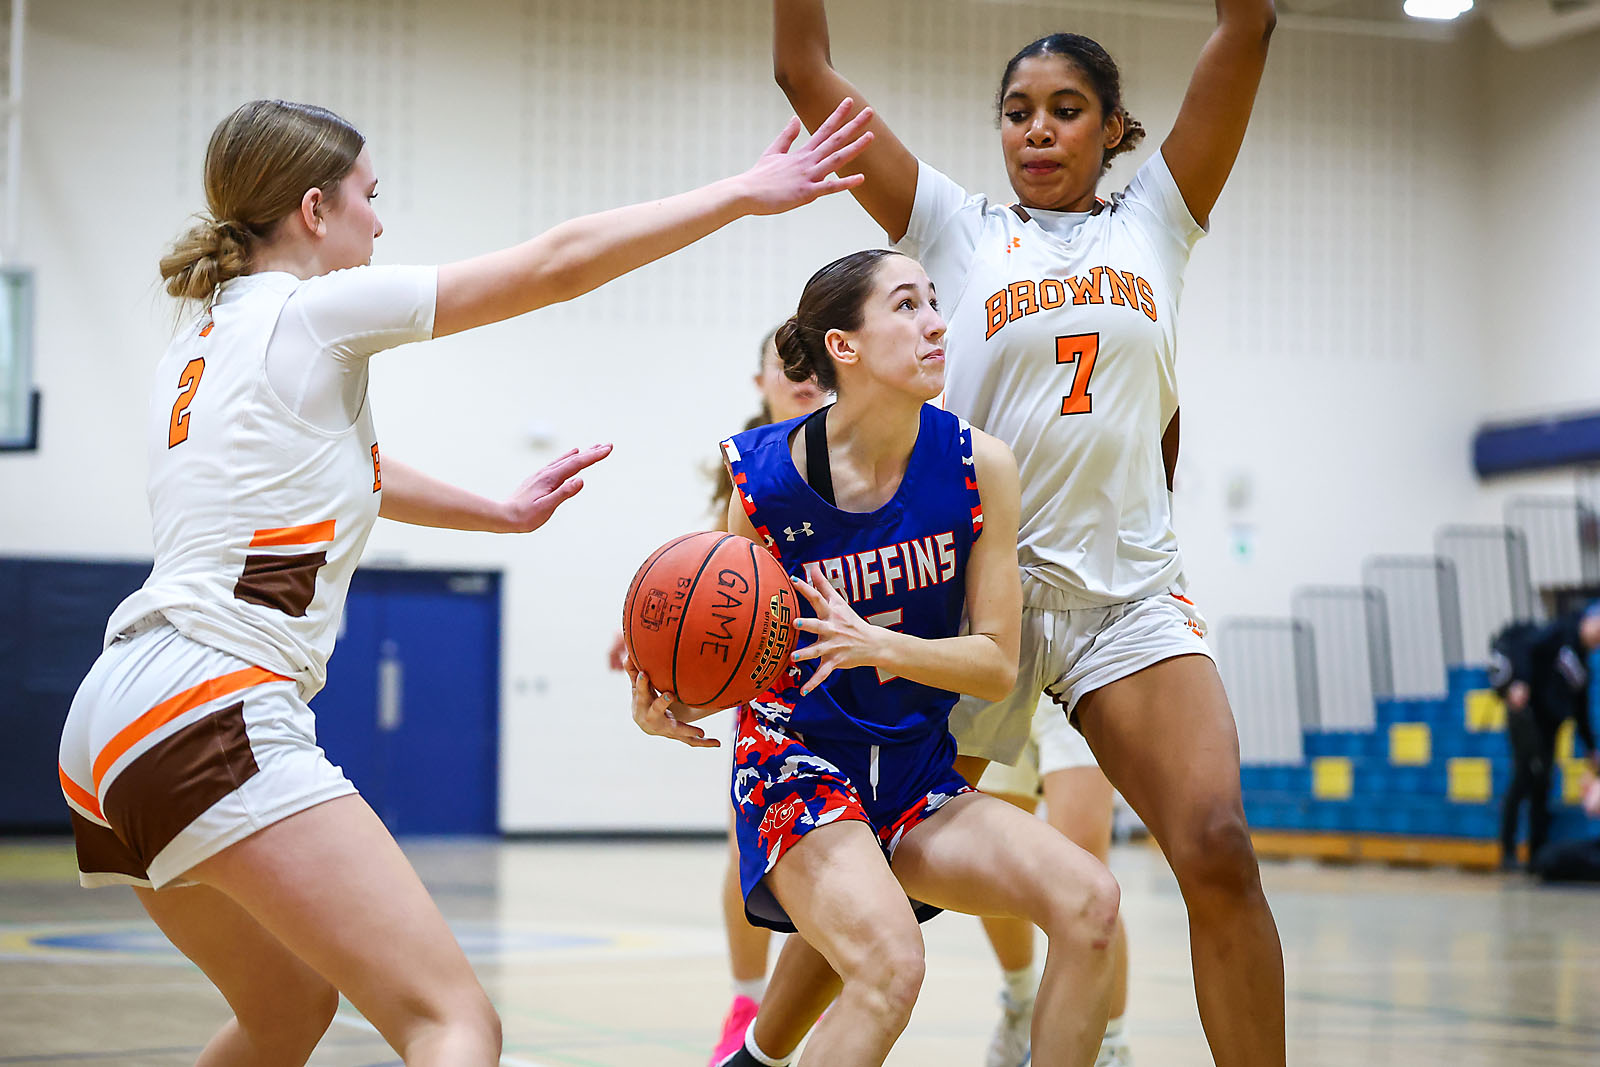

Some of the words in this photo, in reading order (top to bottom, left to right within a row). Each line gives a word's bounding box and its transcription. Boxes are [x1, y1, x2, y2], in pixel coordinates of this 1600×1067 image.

[985, 266, 1157, 341] BROWNS
[168, 356, 206, 450] 2
[1055, 332, 1100, 416] 7
[666, 577, 691, 627] BALL
[700, 568, 749, 663] GAME
[755, 588, 790, 689] LEGACY
